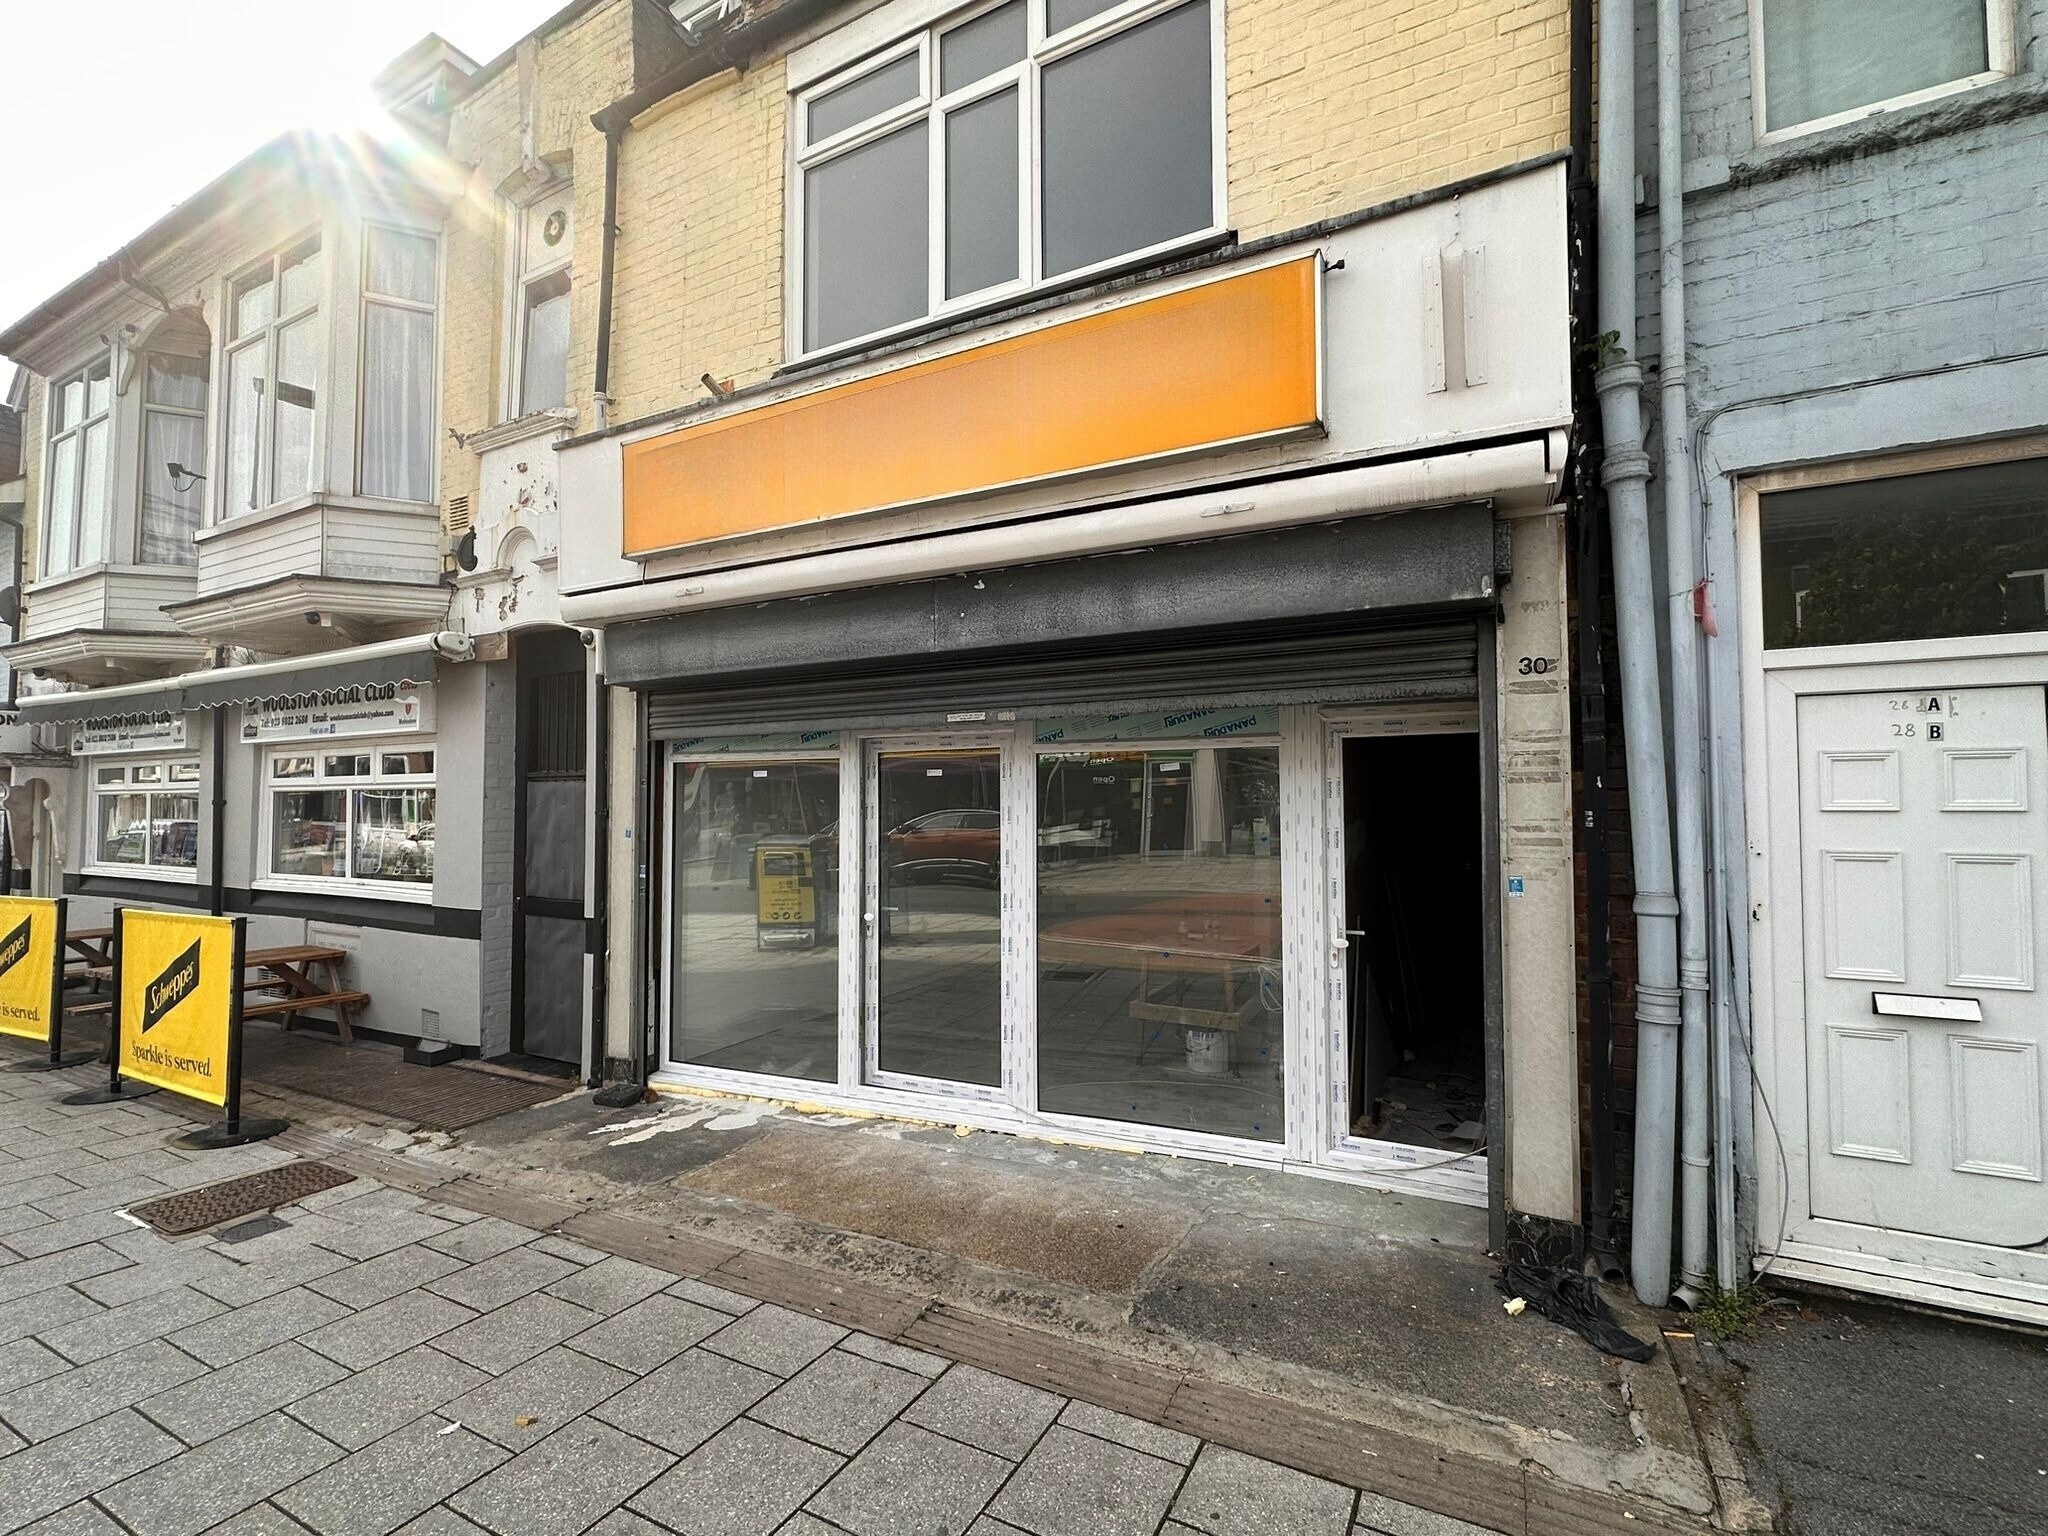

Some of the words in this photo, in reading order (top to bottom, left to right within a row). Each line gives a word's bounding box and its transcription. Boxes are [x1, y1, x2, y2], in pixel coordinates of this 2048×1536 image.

[1518, 656, 1548, 675] 30
[262, 692, 318, 712] WOOLSTON
[321, 686, 361, 707] SOCIAL
[365, 682, 395, 701] CLUB
[1928, 697, 1941, 711] A
[1891, 723, 1916, 737] 28
[1929, 725, 1941, 739] B
[0, 933, 26, 965] eppes
[150, 961, 194, 1014] Schweppes
[2, 1002, 10, 1017] is
[10, 1005, 41, 1022] served.
[131, 1040, 164, 1063] Sparkle
[165, 1049, 173, 1068] is
[174, 1057, 212, 1078] served.
